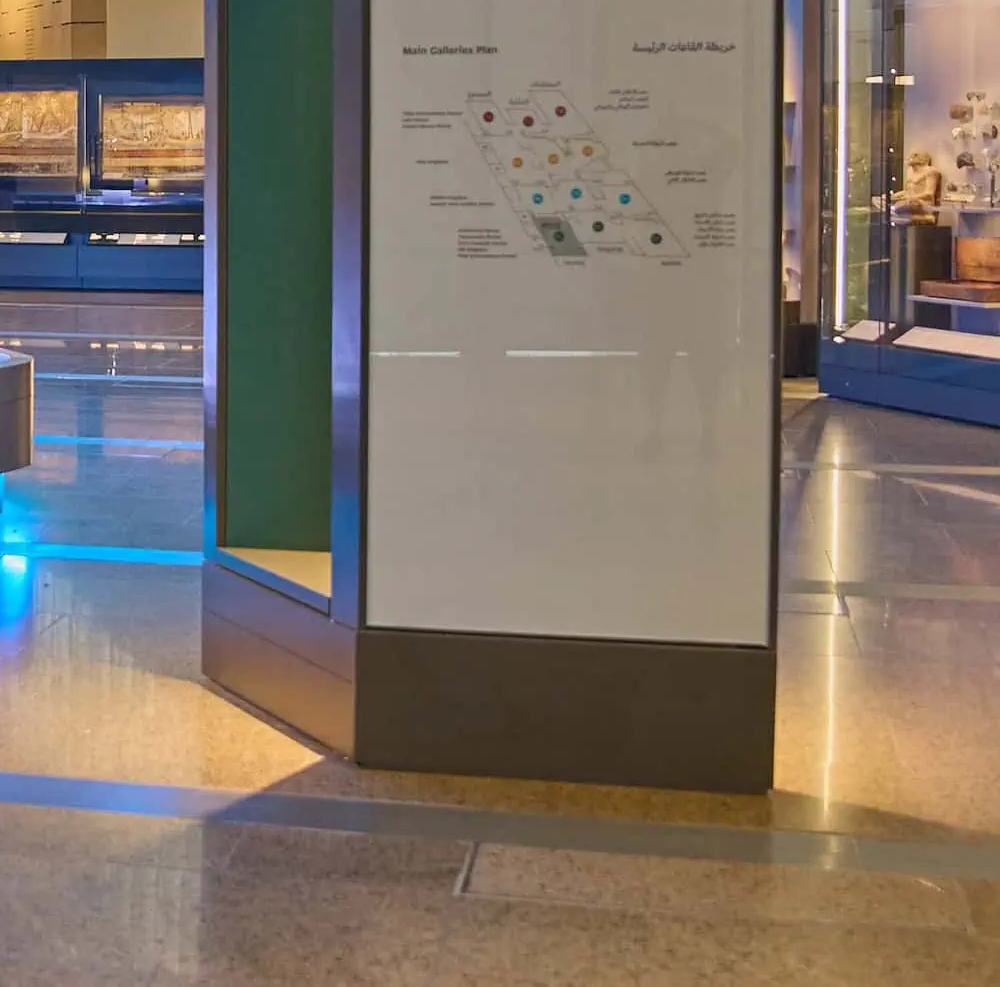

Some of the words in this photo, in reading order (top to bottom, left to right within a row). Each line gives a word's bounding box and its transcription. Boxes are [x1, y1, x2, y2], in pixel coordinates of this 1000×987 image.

[402, 45, 427, 55] Main
[430, 45, 473, 55] Galleries
[476, 45, 498, 55] Plan
[667, 40, 703, 53] القاعات
[704, 41, 737, 54] خريطة
